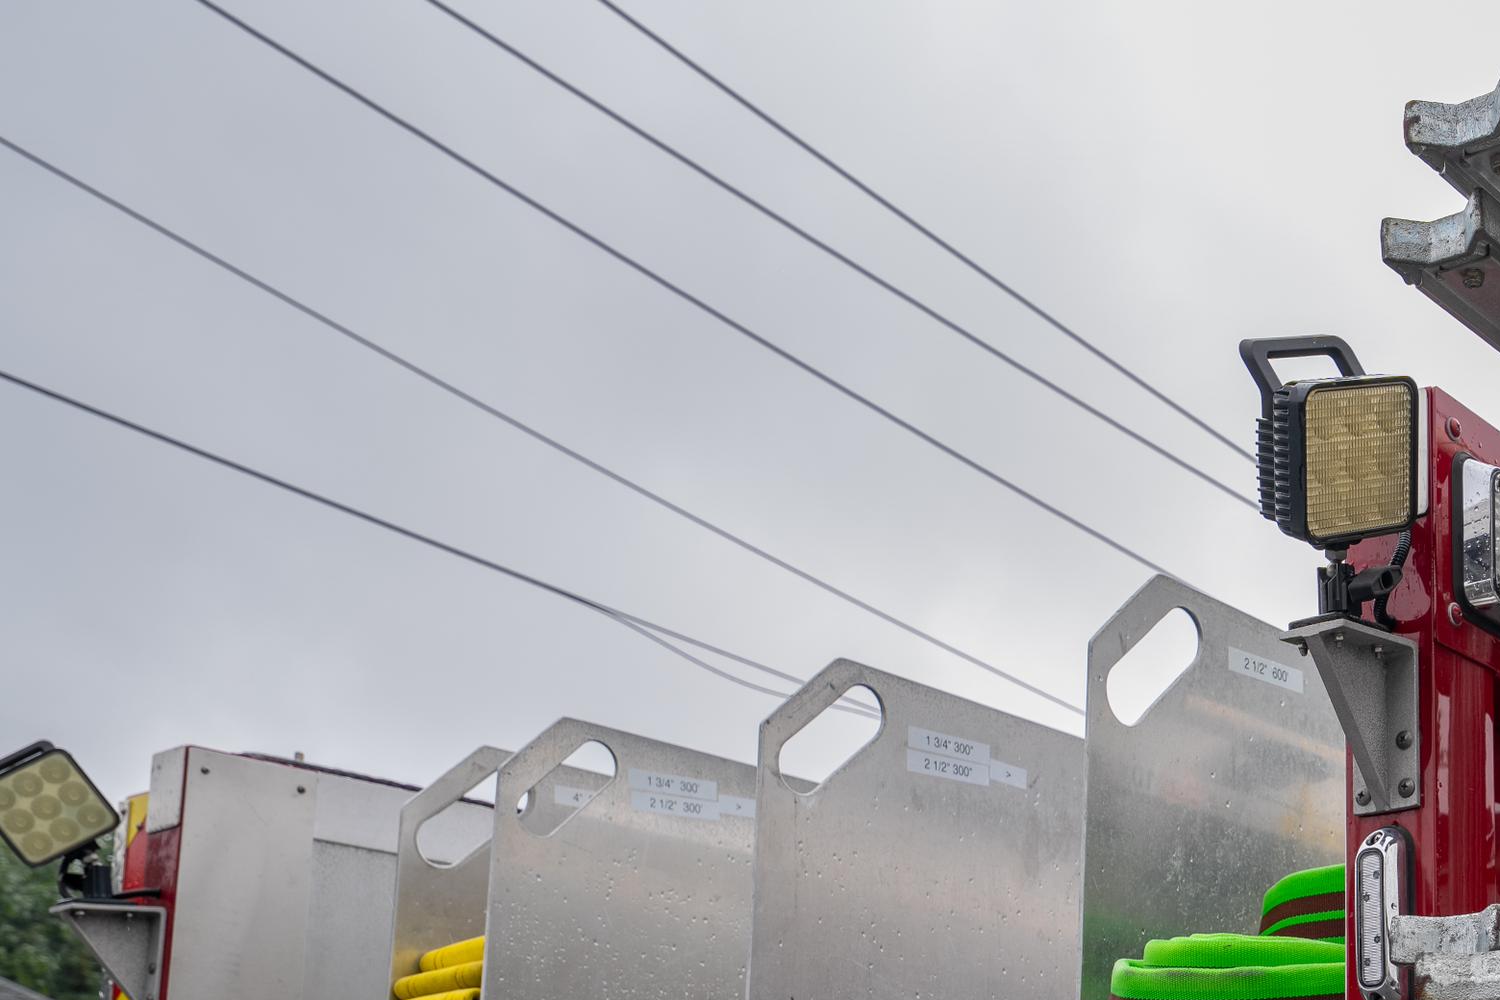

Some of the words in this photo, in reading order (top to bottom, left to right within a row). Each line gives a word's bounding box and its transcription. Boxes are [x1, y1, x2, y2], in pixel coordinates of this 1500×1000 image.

[1244, 657, 1250, 670] 2
[934, 736, 951, 750] 3/4"
[924, 758, 930, 770] 2
[934, 760, 950, 773] 1/2"
[650, 797, 656, 809] 2
